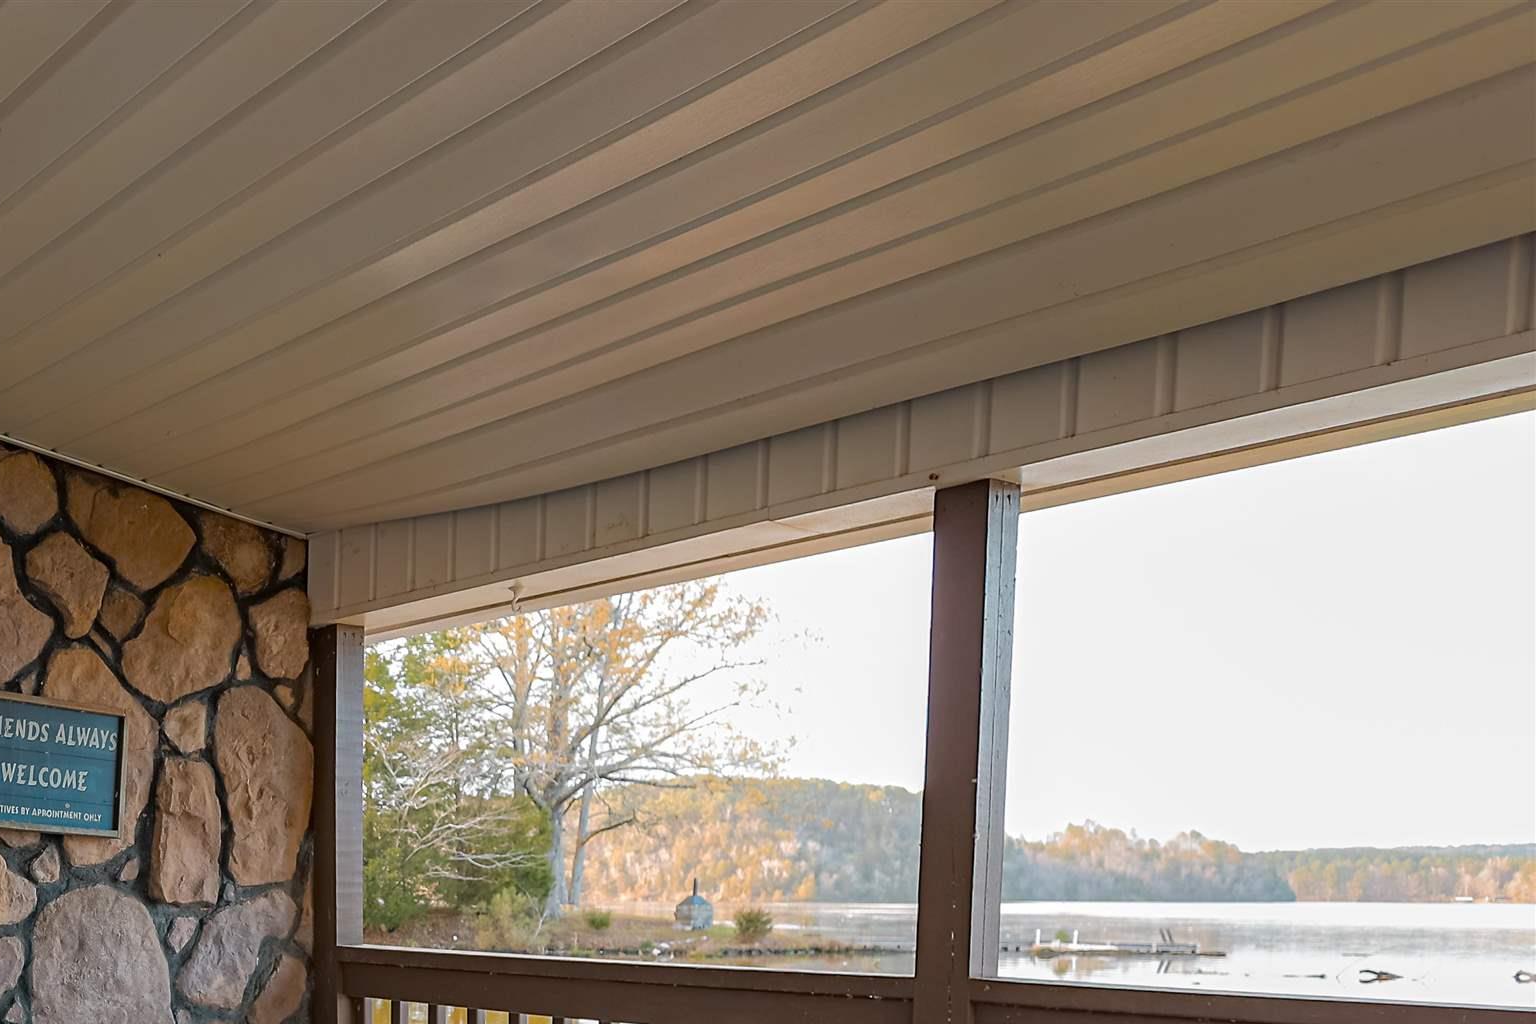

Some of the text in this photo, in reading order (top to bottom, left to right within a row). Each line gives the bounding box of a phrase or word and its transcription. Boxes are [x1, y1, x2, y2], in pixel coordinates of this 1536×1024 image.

[55, 724, 118, 751] ALWAYS
[1, 762, 88, 792] WELCOME
[20, 807, 30, 816] BY
[83, 813, 102, 822] ONLY
